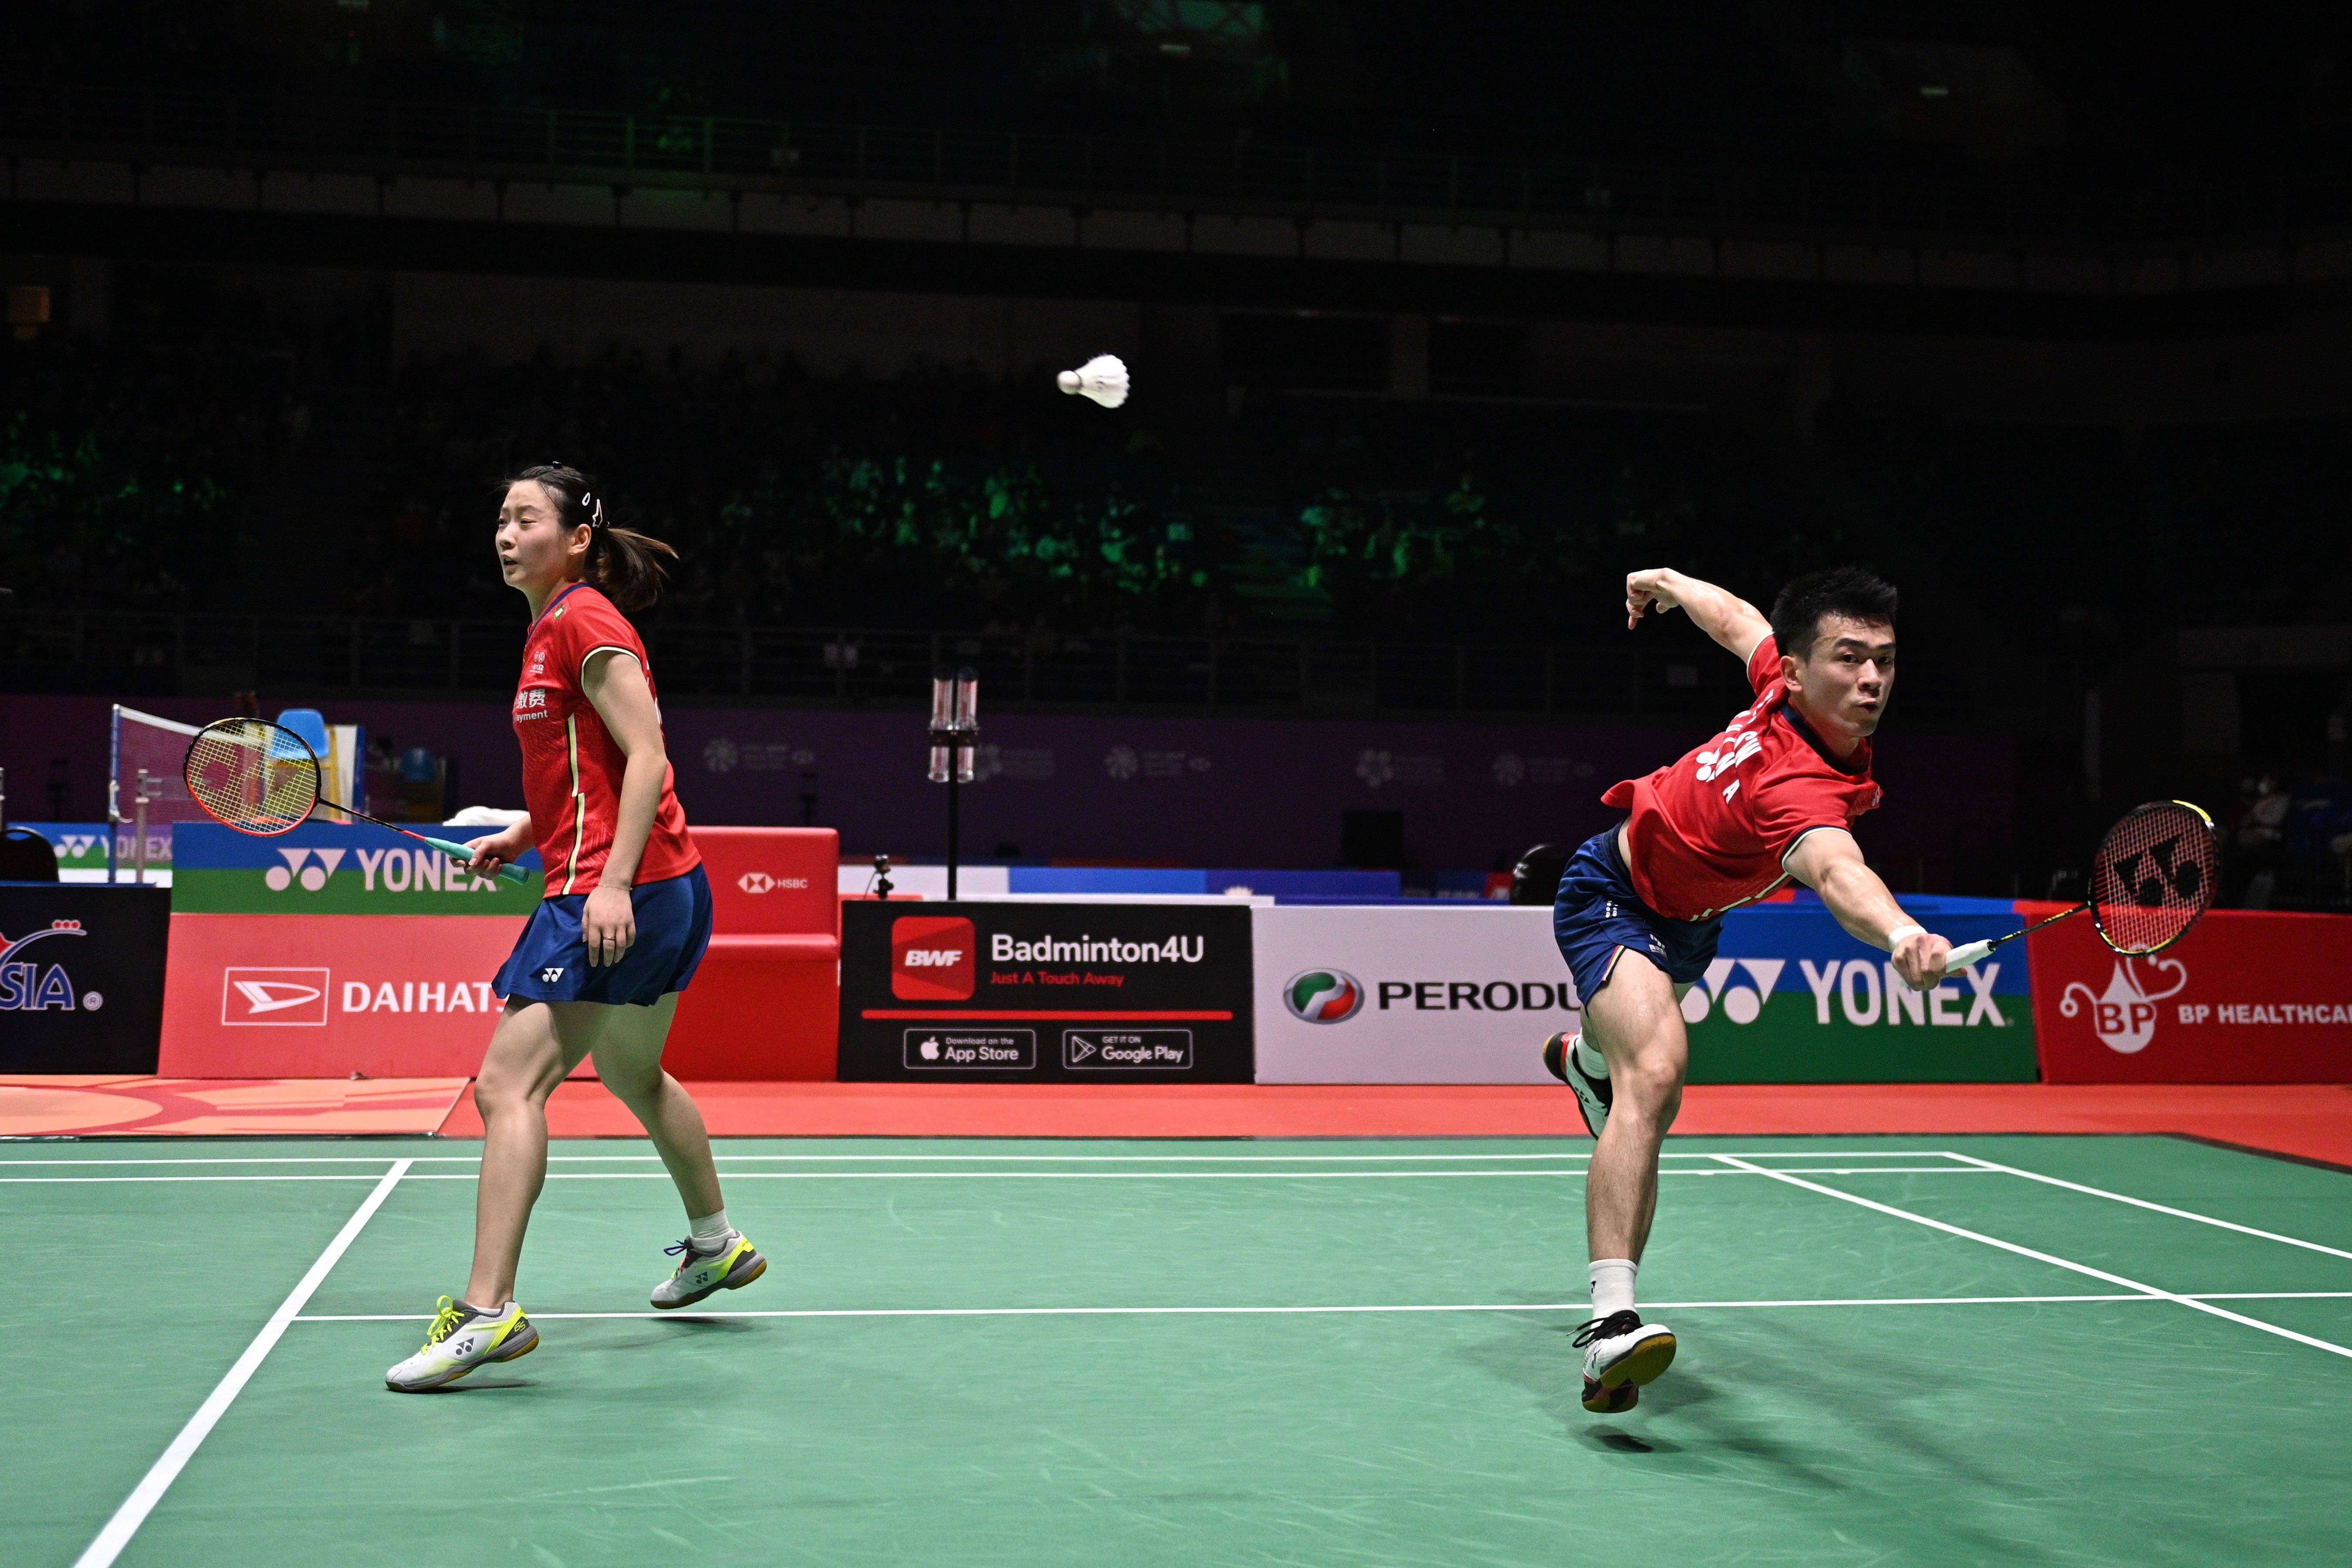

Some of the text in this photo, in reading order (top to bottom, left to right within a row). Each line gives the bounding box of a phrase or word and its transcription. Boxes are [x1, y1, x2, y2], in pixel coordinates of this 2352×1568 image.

[515, 710, 548, 723] ayment
[777, 879, 808, 889] HSBC
[992, 934, 1204, 963] Badminton4U
[905, 950, 963, 966] BWF
[990, 971, 1125, 987] Just A Touch Away
[343, 981, 510, 1012] DAIHAT
[2095, 1003, 2154, 1035] BP
[2178, 1004, 2210, 1024] BP
[945, 1047, 1019, 1062] App Store
[1102, 1046, 1183, 1063] Google Play
[514, 1321, 526, 1332] 65
